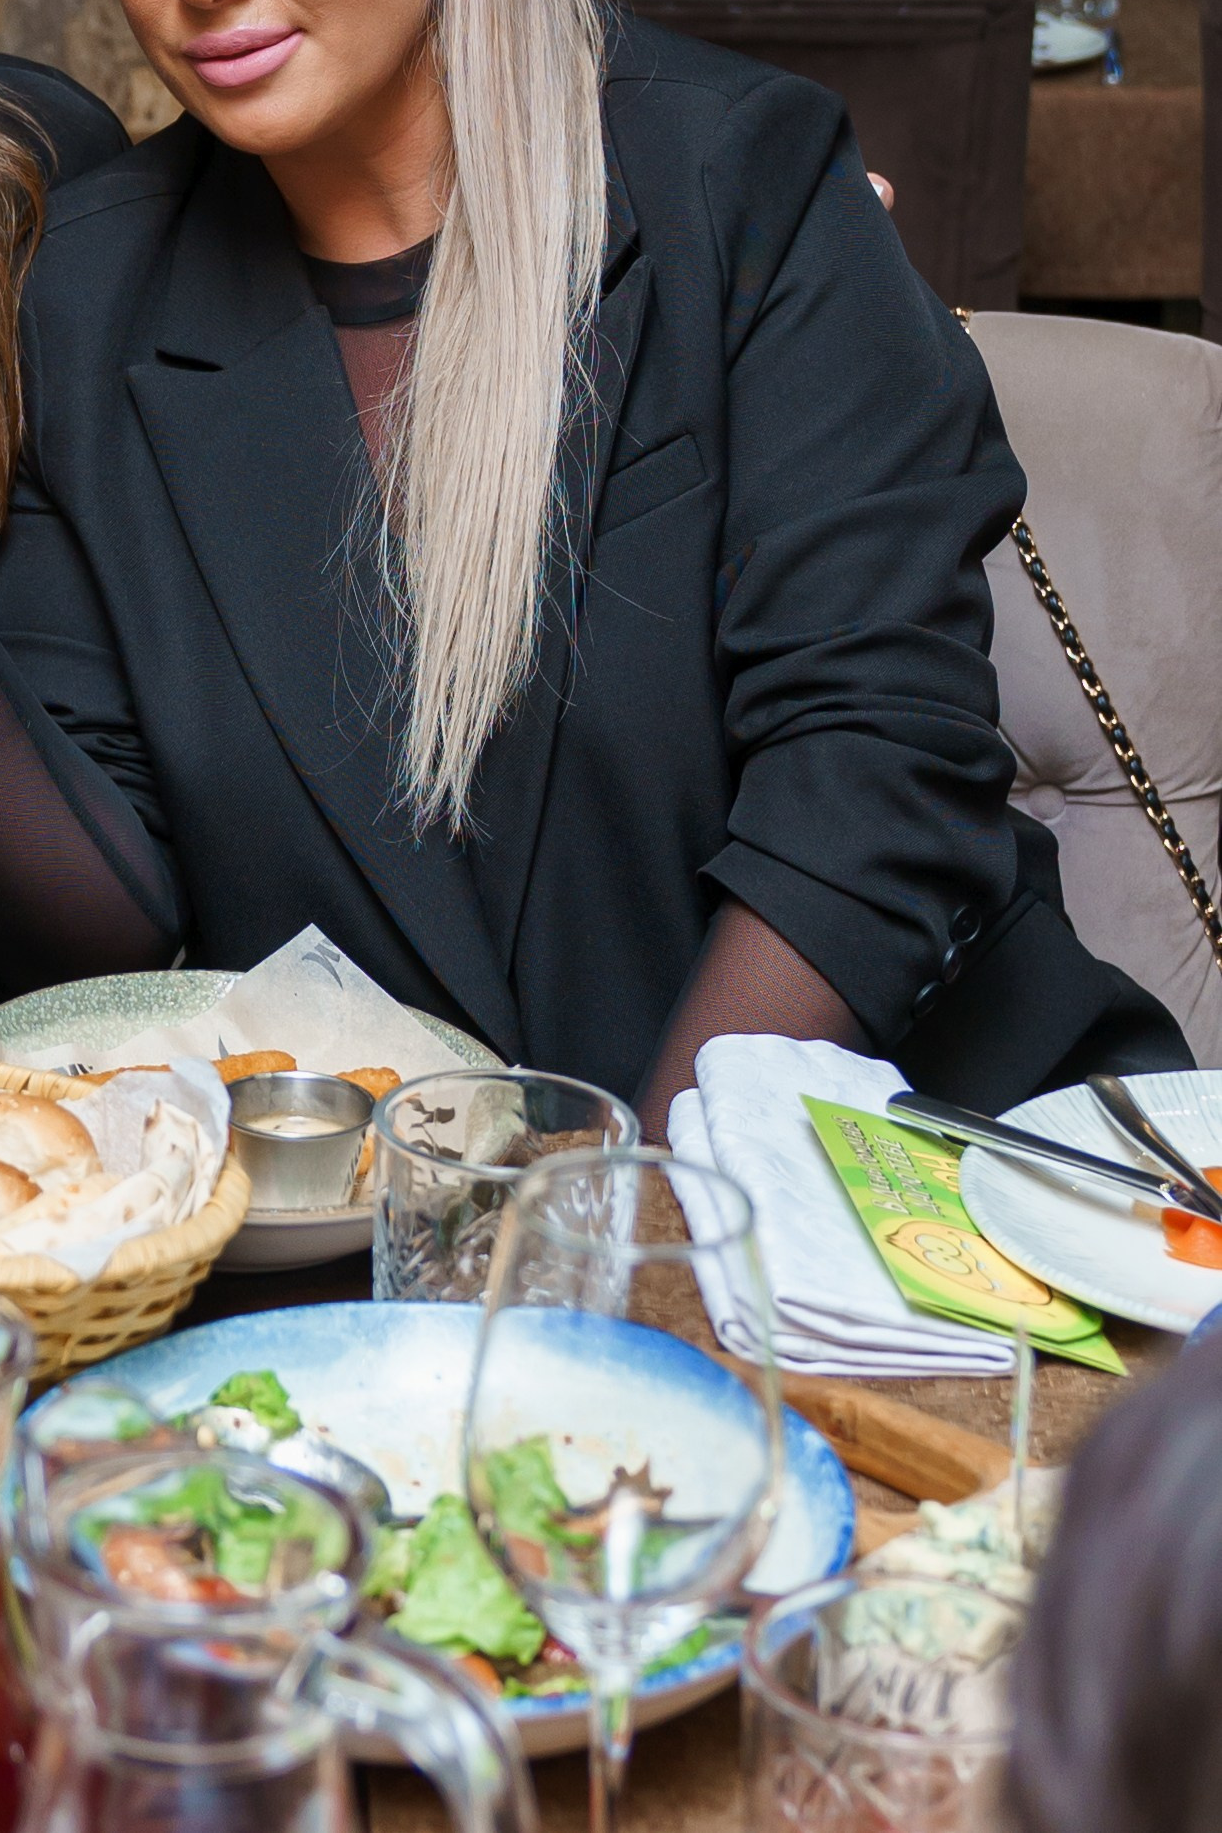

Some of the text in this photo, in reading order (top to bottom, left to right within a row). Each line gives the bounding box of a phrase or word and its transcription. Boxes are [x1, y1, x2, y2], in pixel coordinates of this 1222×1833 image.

[866, 1166, 906, 1204] ДЕНЬ
[872, 1134, 944, 1217] ДАРЮ ТЕБЕ
